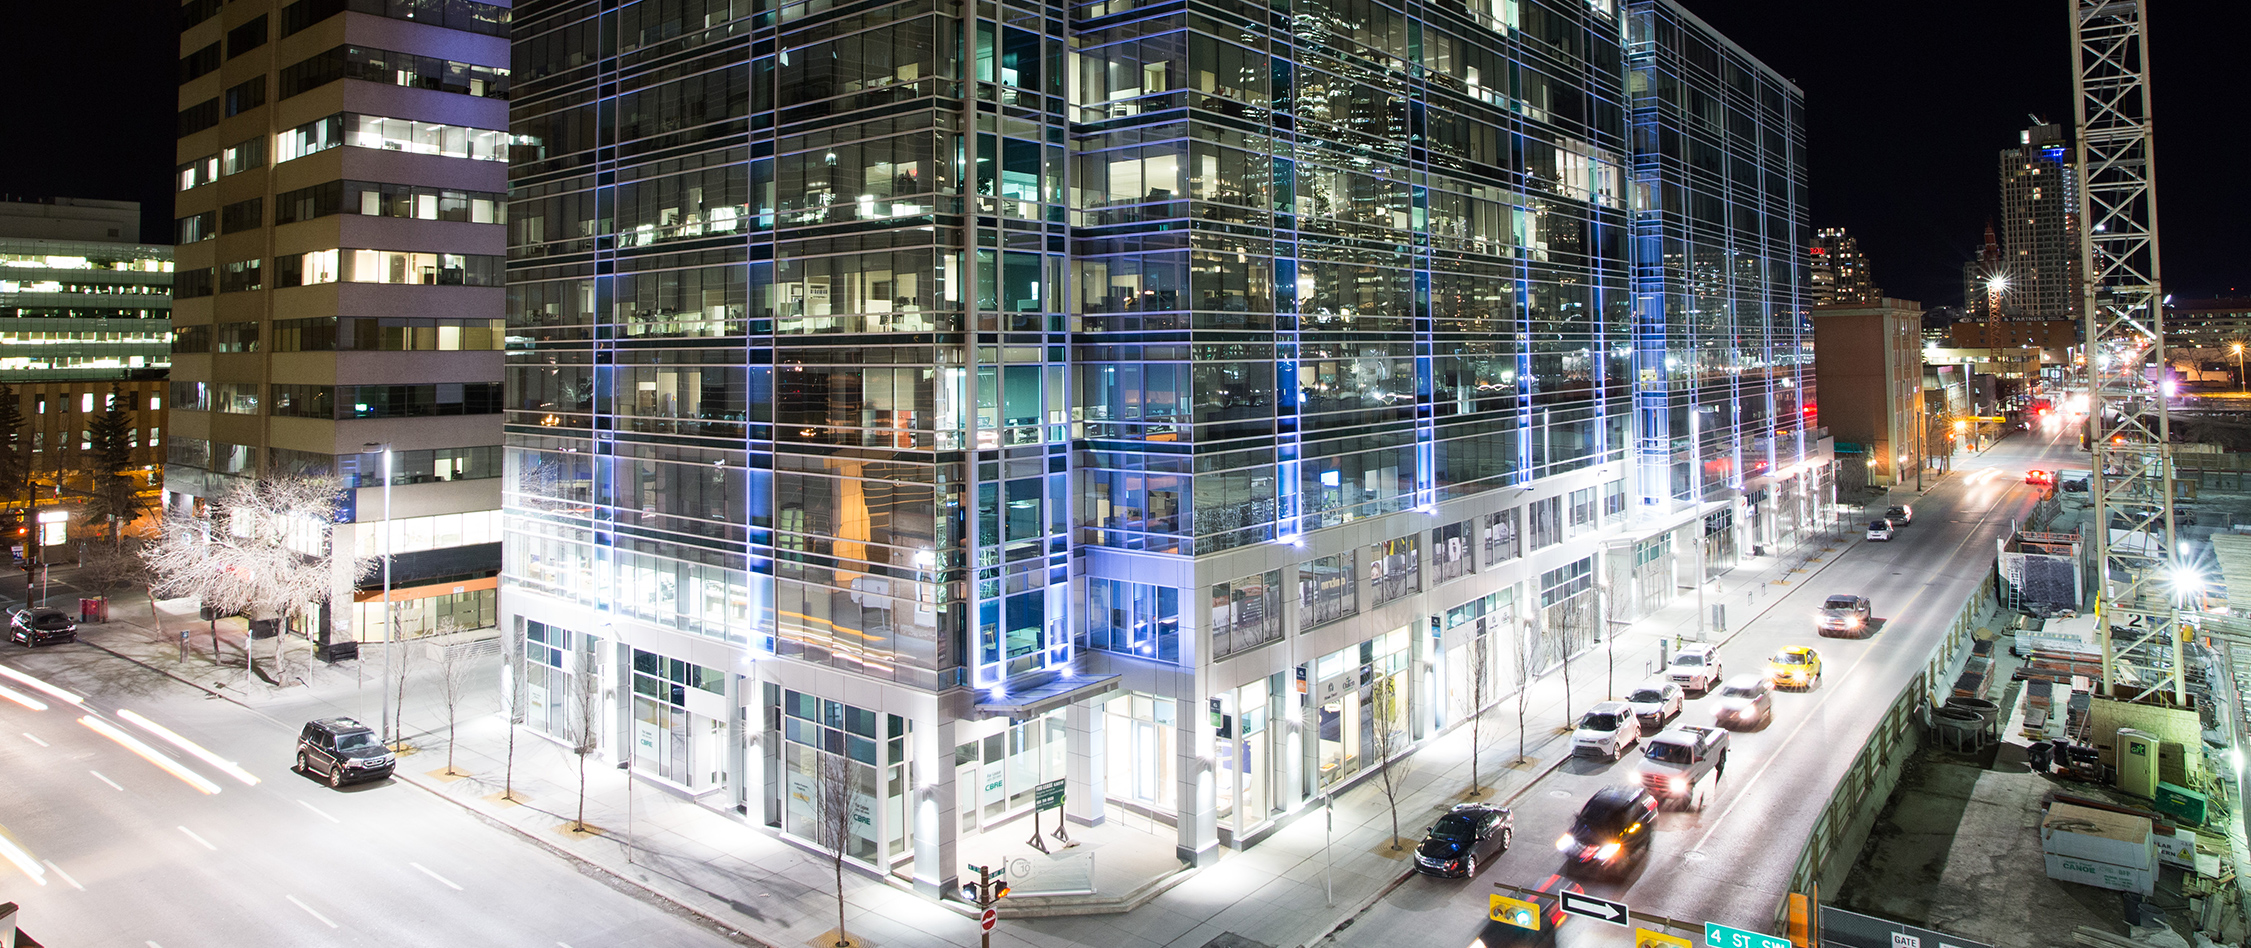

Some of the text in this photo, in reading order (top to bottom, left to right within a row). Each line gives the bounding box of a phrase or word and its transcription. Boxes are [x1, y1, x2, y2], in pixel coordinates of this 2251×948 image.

[2128, 613, 2142, 627] 2
[985, 780, 1003, 791] CBRE
[853, 813, 871, 825] CBRE
[2161, 849, 2176, 857] ERN
[2063, 862, 2096, 874] CANOE
[1710, 928, 1722, 943] 4
[1732, 933, 1751, 948] ST
[1894, 935, 1917, 947] GATE
